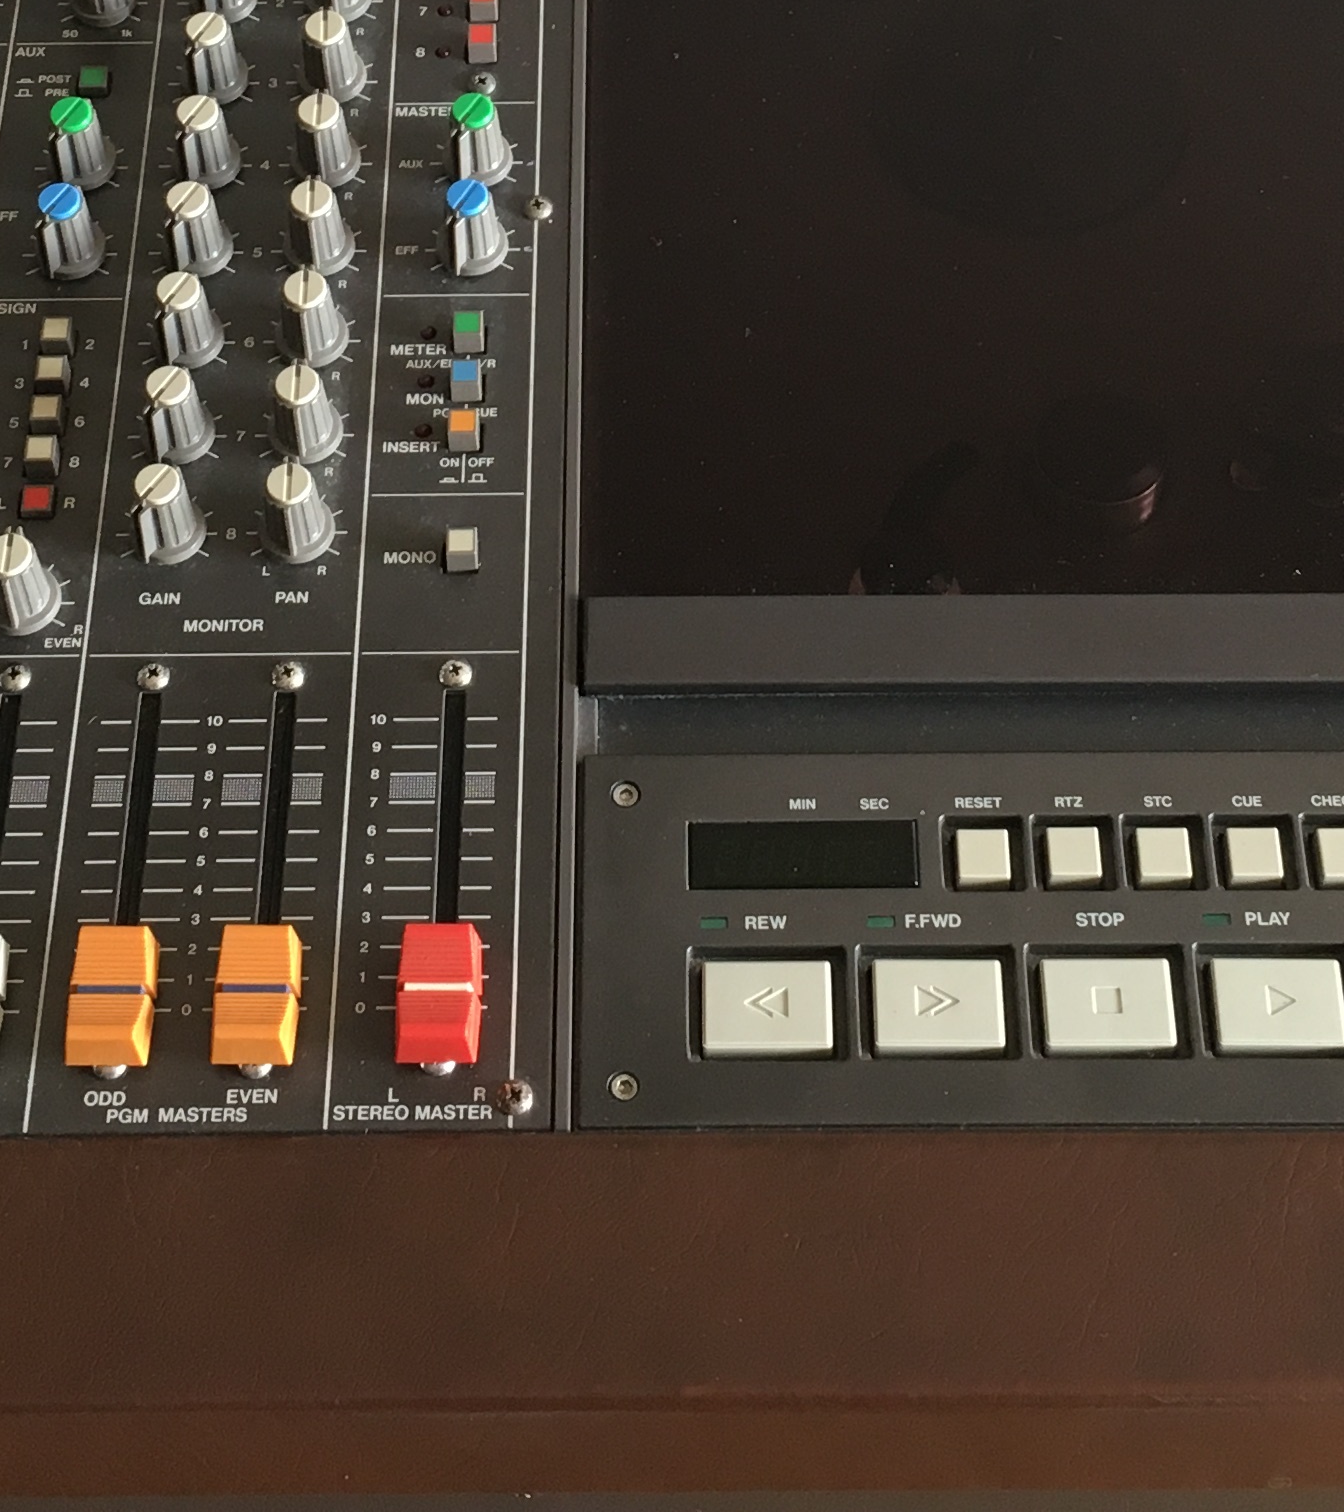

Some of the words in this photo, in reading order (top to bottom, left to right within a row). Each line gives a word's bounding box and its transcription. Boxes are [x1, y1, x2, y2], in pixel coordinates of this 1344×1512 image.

[15, 47, 45, 57] AUX
[399, 160, 423, 168] AUX
[395, 246, 418, 255] EFF
[391, 344, 446, 355] METER
[406, 393, 443, 405] MON
[383, 442, 440, 453] INSERT
[440, 458, 459, 467] ON
[468, 457, 494, 467] OFF
[384, 551, 435, 564] MONO
[139, 593, 180, 605] GAIN
[275, 591, 308, 603] PAN
[184, 619, 263, 632] MONITOR
[789, 799, 816, 809] MIN
[860, 798, 889, 810] SEC
[955, 797, 1002, 808] RESET
[1055, 796, 1083, 807] RTZ
[1144, 796, 1172, 807] STC
[1232, 796, 1262, 807] CUE
[745, 916, 786, 930] REW
[905, 914, 961, 928] F.FWD
[1076, 912, 1124, 927] STOP
[1245, 912, 1290, 925] PLAY
[84, 1091, 126, 1106] ODD
[227, 1089, 277, 1104] EVEN
[106, 1108, 148, 1123] PGM
[159, 1107, 247, 1122] MASTERS
[333, 1105, 409, 1120] STEREO
[415, 1105, 492, 1120] MASTER
